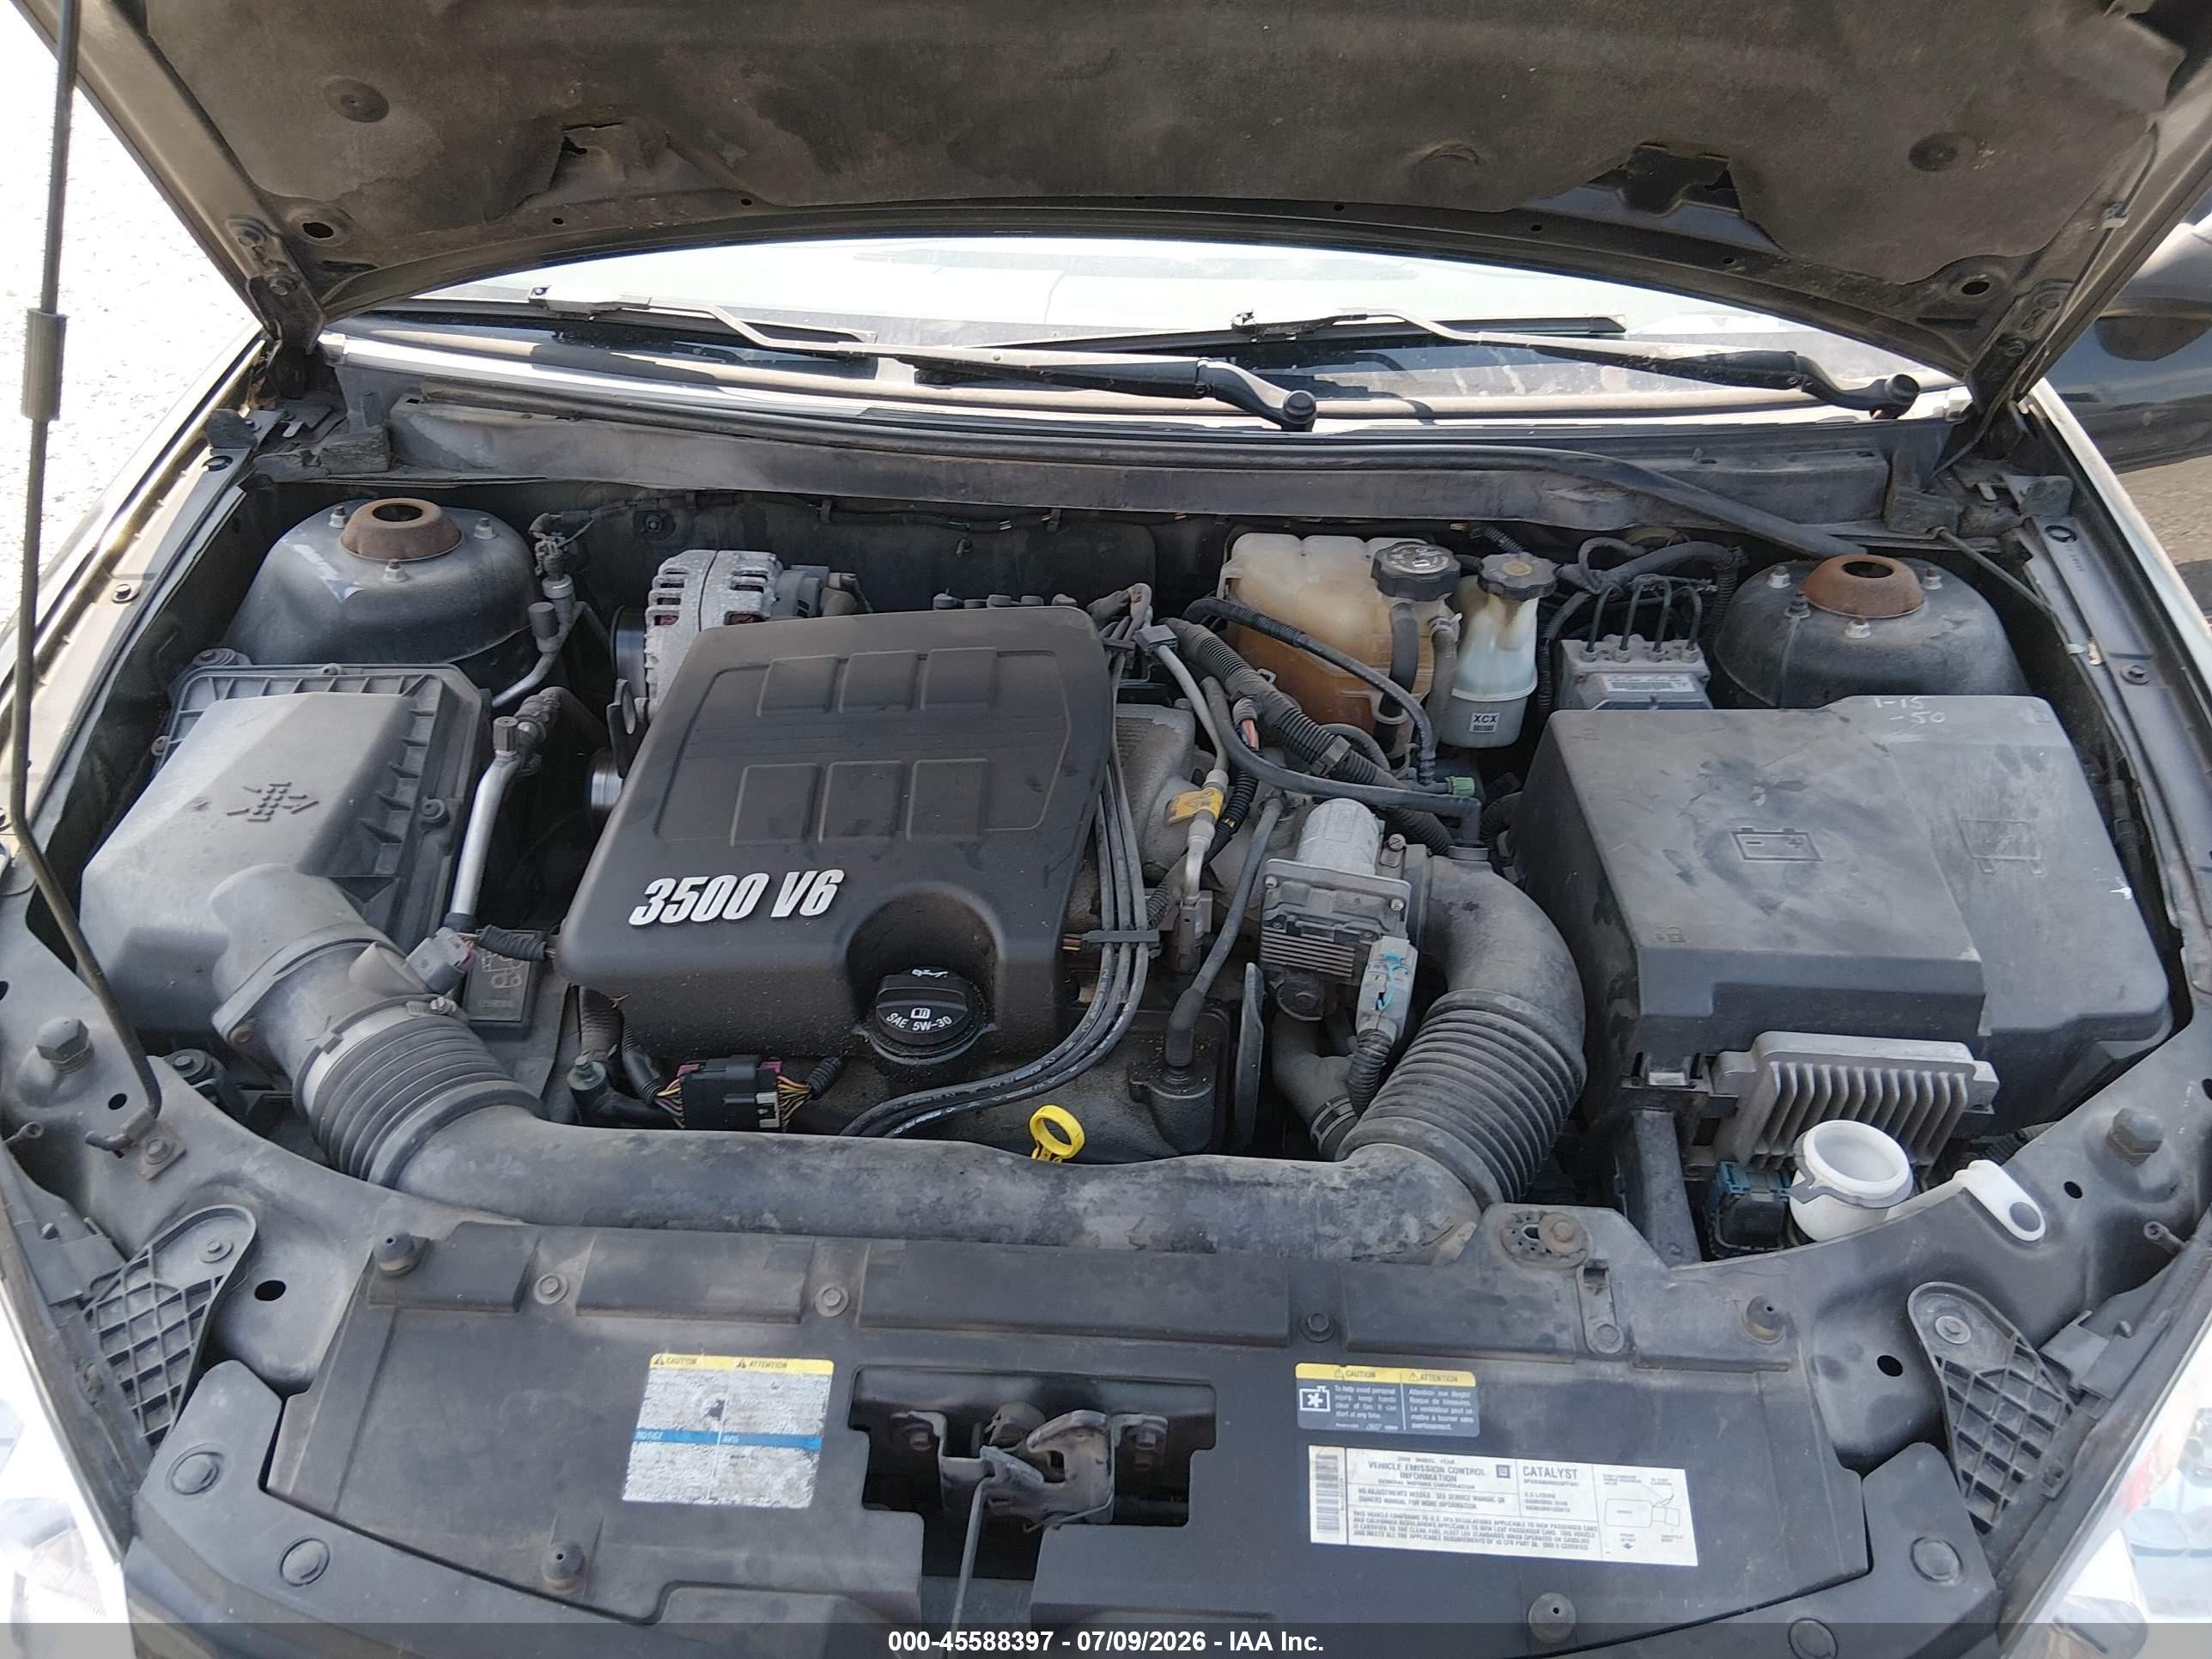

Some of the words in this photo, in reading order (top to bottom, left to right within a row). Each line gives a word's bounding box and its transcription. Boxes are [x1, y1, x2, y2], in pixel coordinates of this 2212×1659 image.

[1473, 714, 1498, 724] XCX
[628, 872, 770, 926] 3500
[769, 869, 846, 918] V6
[886, 1012, 909, 1029] SAE
[912, 1016, 953, 1031] 5W-30
[665, 1357, 697, 1365] CAUTION
[748, 1360, 788, 1370] ATTENTION
[1346, 1370, 1376, 1378] CAUTION
[1419, 1373, 1458, 1382] ATTENTION
[1368, 1461, 1401, 1471] VEHICLE
[1405, 1463, 1444, 1474] EMISSION
[1448, 1467, 1486, 1476] CONTROL
[1522, 1465, 1578, 1480] CATALYST
[1400, 1471, 1457, 1482] INFORMATION
